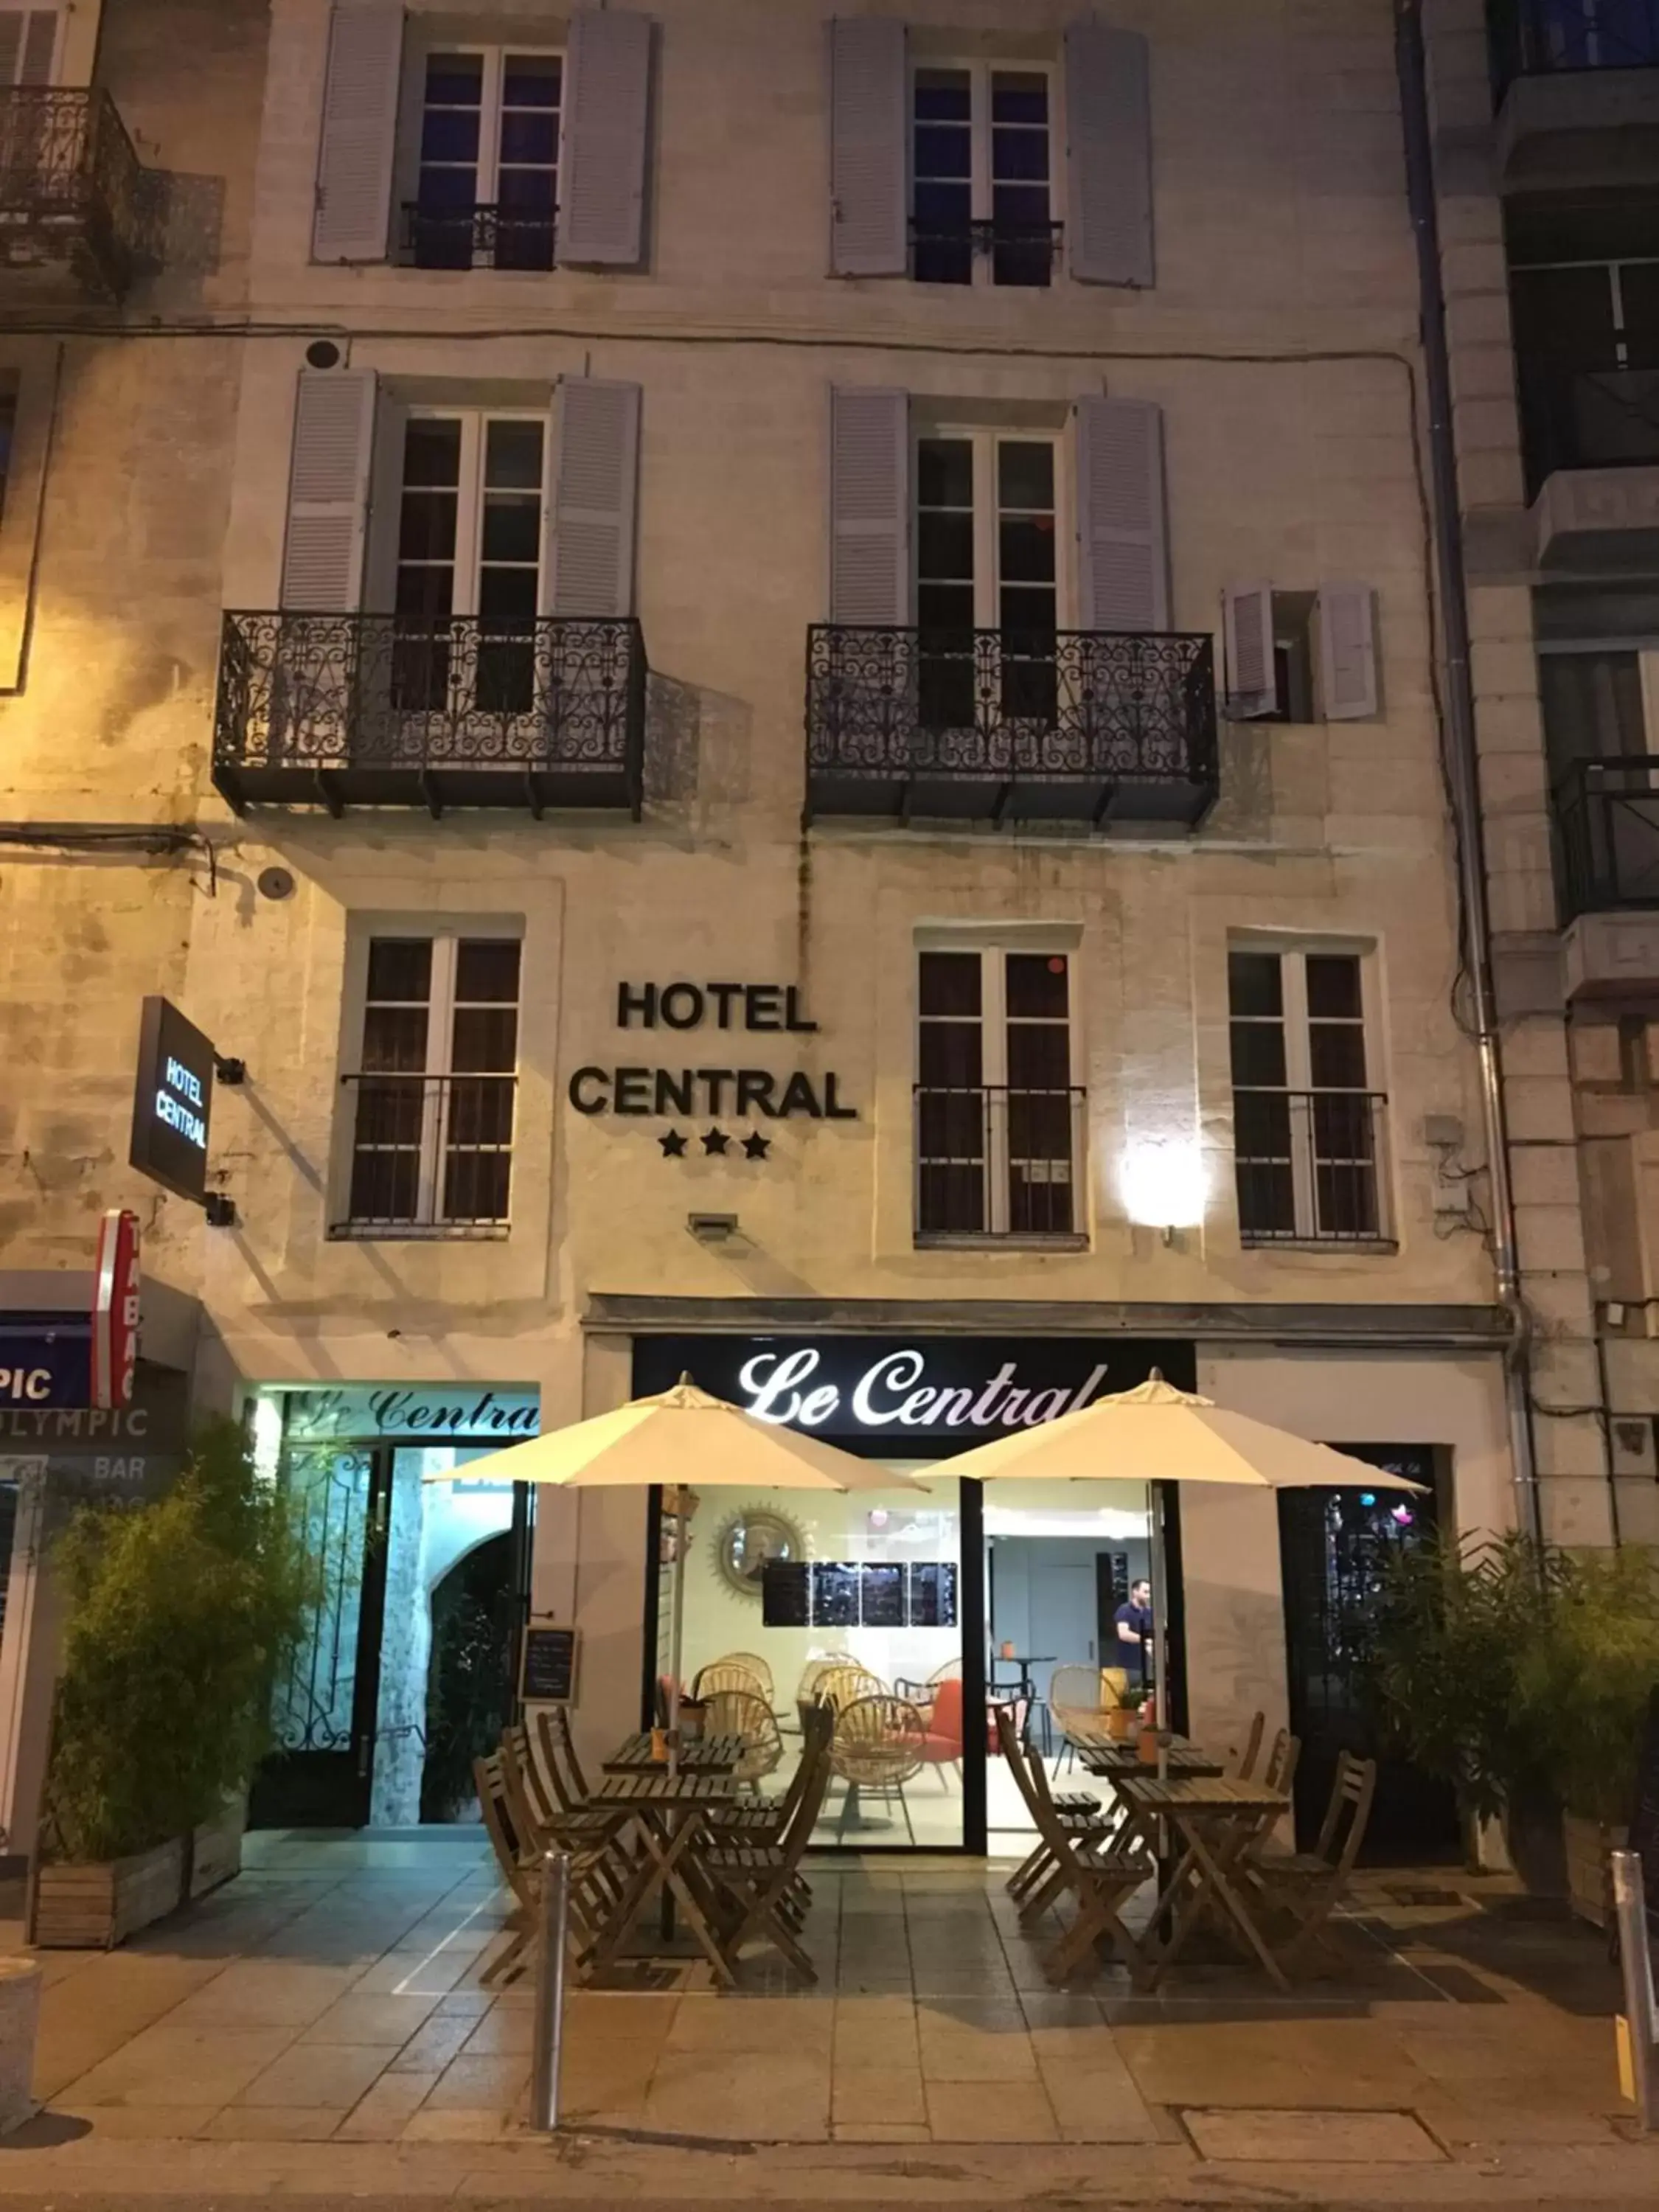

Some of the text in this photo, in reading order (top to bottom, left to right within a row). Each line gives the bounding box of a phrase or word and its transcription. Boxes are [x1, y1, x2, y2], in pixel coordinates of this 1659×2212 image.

[617, 981, 818, 1031] HOTEL
[167, 1056, 203, 1107] HOTEL
[568, 1066, 858, 1119] CENTRAL
[156, 1088, 206, 1150] CENTRAL
[739, 1348, 1108, 1426] Le Central
[0, 1409, 147, 1437] LYMPIC
[94, 1456, 146, 1479] BAR
